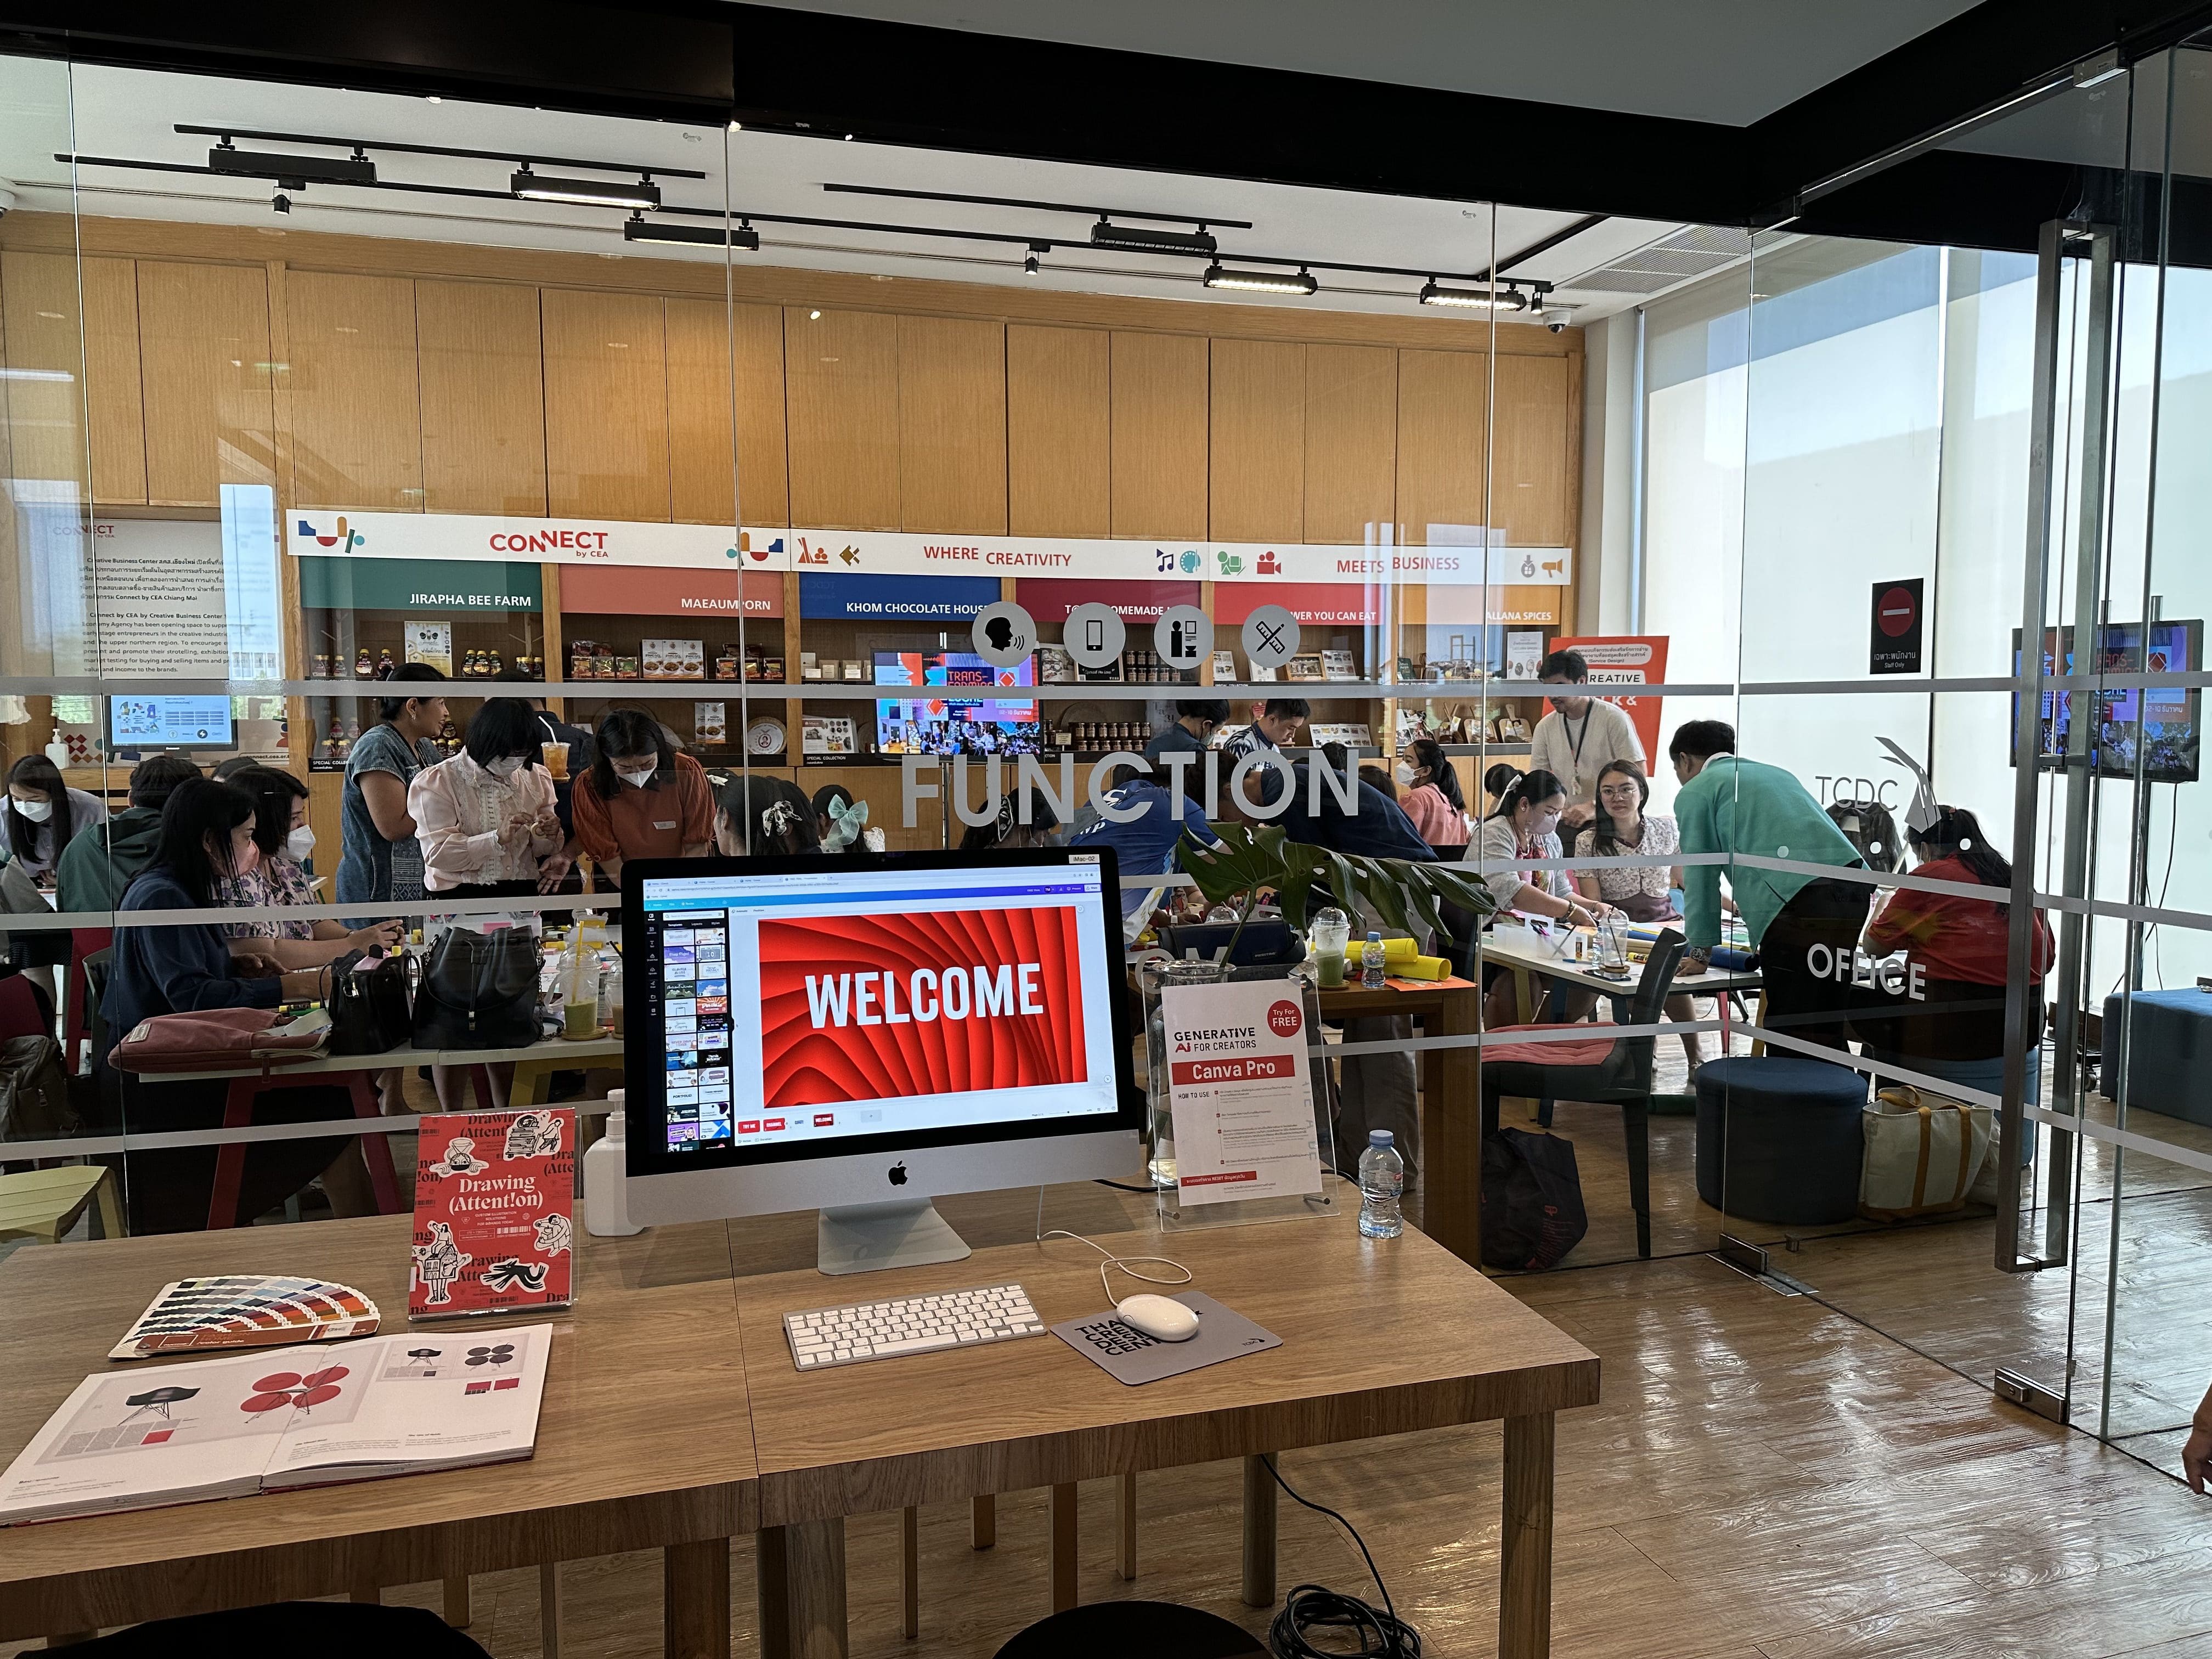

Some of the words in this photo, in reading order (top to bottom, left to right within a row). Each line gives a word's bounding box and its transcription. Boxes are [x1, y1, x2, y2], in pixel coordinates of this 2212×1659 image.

[489, 529, 608, 552] CONNECT
[923, 546, 979, 560] WHERE
[985, 552, 1072, 567] CREATIVITY
[1336, 560, 1385, 573] MEETS
[1392, 556, 1459, 571] BUSINESS
[409, 593, 465, 605] JIRAPHA
[468, 595, 492, 606] BEE
[494, 596, 532, 606] FARM
[681, 597, 771, 610] MAEAUMORN
[846, 602, 883, 613] KHOM
[885, 602, 951, 614] CHOCOLATE
[1110, 606, 1164, 616] OMEMADE
[1290, 612, 1312, 621] WER
[1314, 612, 1335, 620] YOU
[1337, 612, 1357, 620] CAN
[1359, 612, 1376, 620] EAT
[1522, 612, 1552, 620] SPICES
[1874, 651, 1916, 661] เฉพาะพนักงาน
[1589, 674, 1640, 682] REATIVE
[901, 749, 1360, 828] FUNCTION
[1815, 776, 1898, 811] TCDC
[1807, 943, 1926, 1001] OFFICE
[804, 962, 1045, 1029] WELCOME
[1272, 1017, 1297, 1027] FREE
[1194, 1043, 1210, 1052] FOR
[1213, 1040, 1256, 1051] CREATORS
[1192, 1064, 1242, 1080] Canva
[1246, 1060, 1276, 1076] Pro
[459, 1175, 536, 1194] Drawing
[448, 1190, 544, 1216] (Attent!on)
